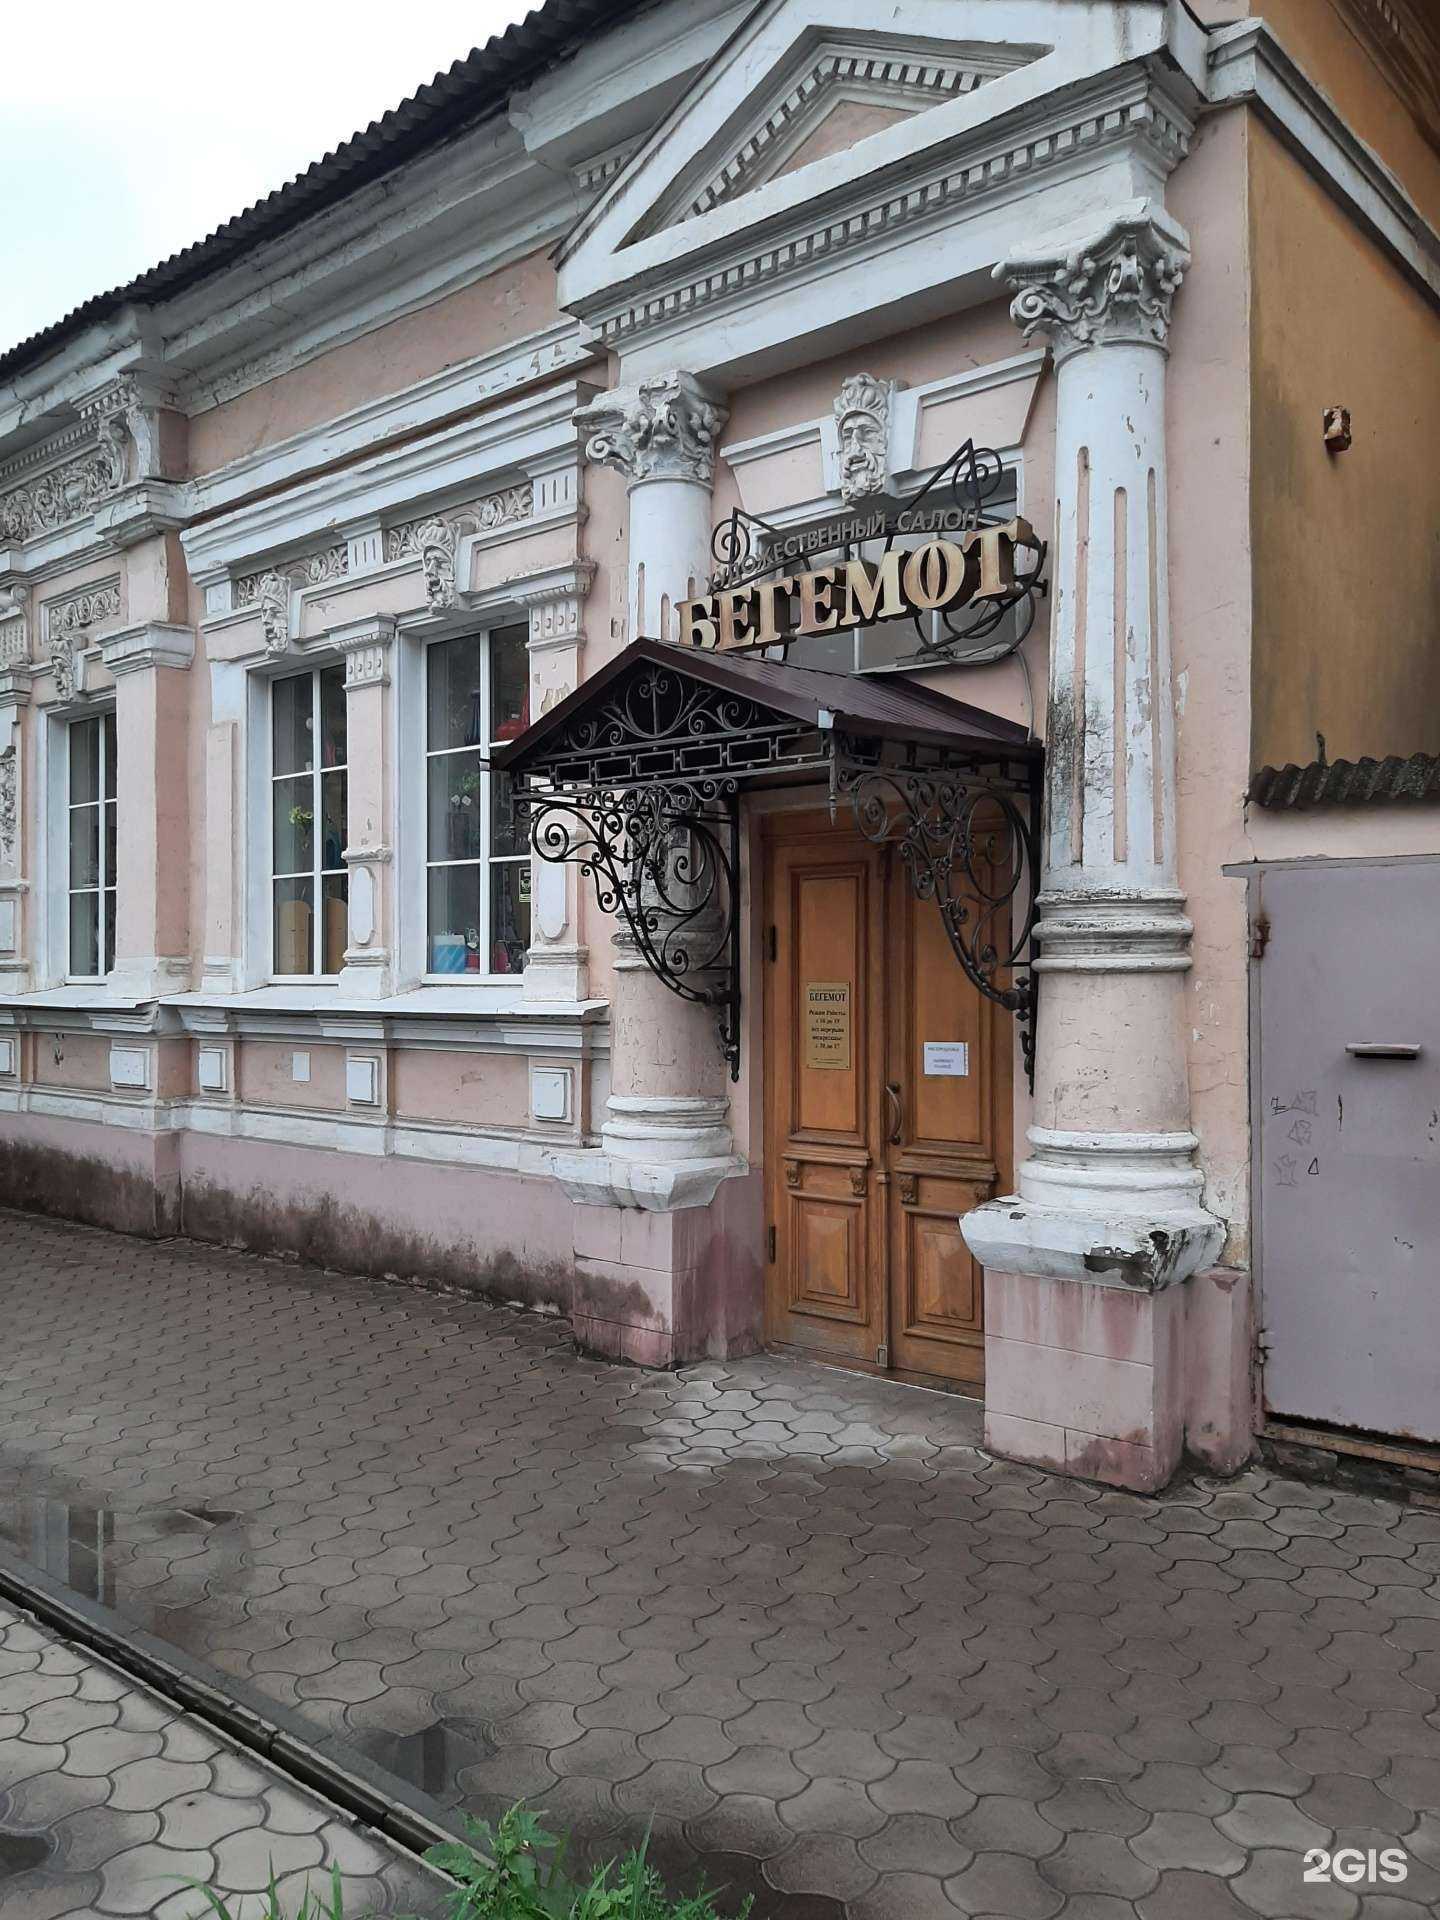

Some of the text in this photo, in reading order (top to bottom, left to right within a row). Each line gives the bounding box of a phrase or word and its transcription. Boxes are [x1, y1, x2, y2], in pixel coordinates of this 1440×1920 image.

[674, 516, 1022, 650] БЕГЕМОТ
[705, 507, 980, 595] ХУДОЖЕСТВЕННЫЙ САЛОН
[809, 992, 847, 1002] БЕГЕМОТ
